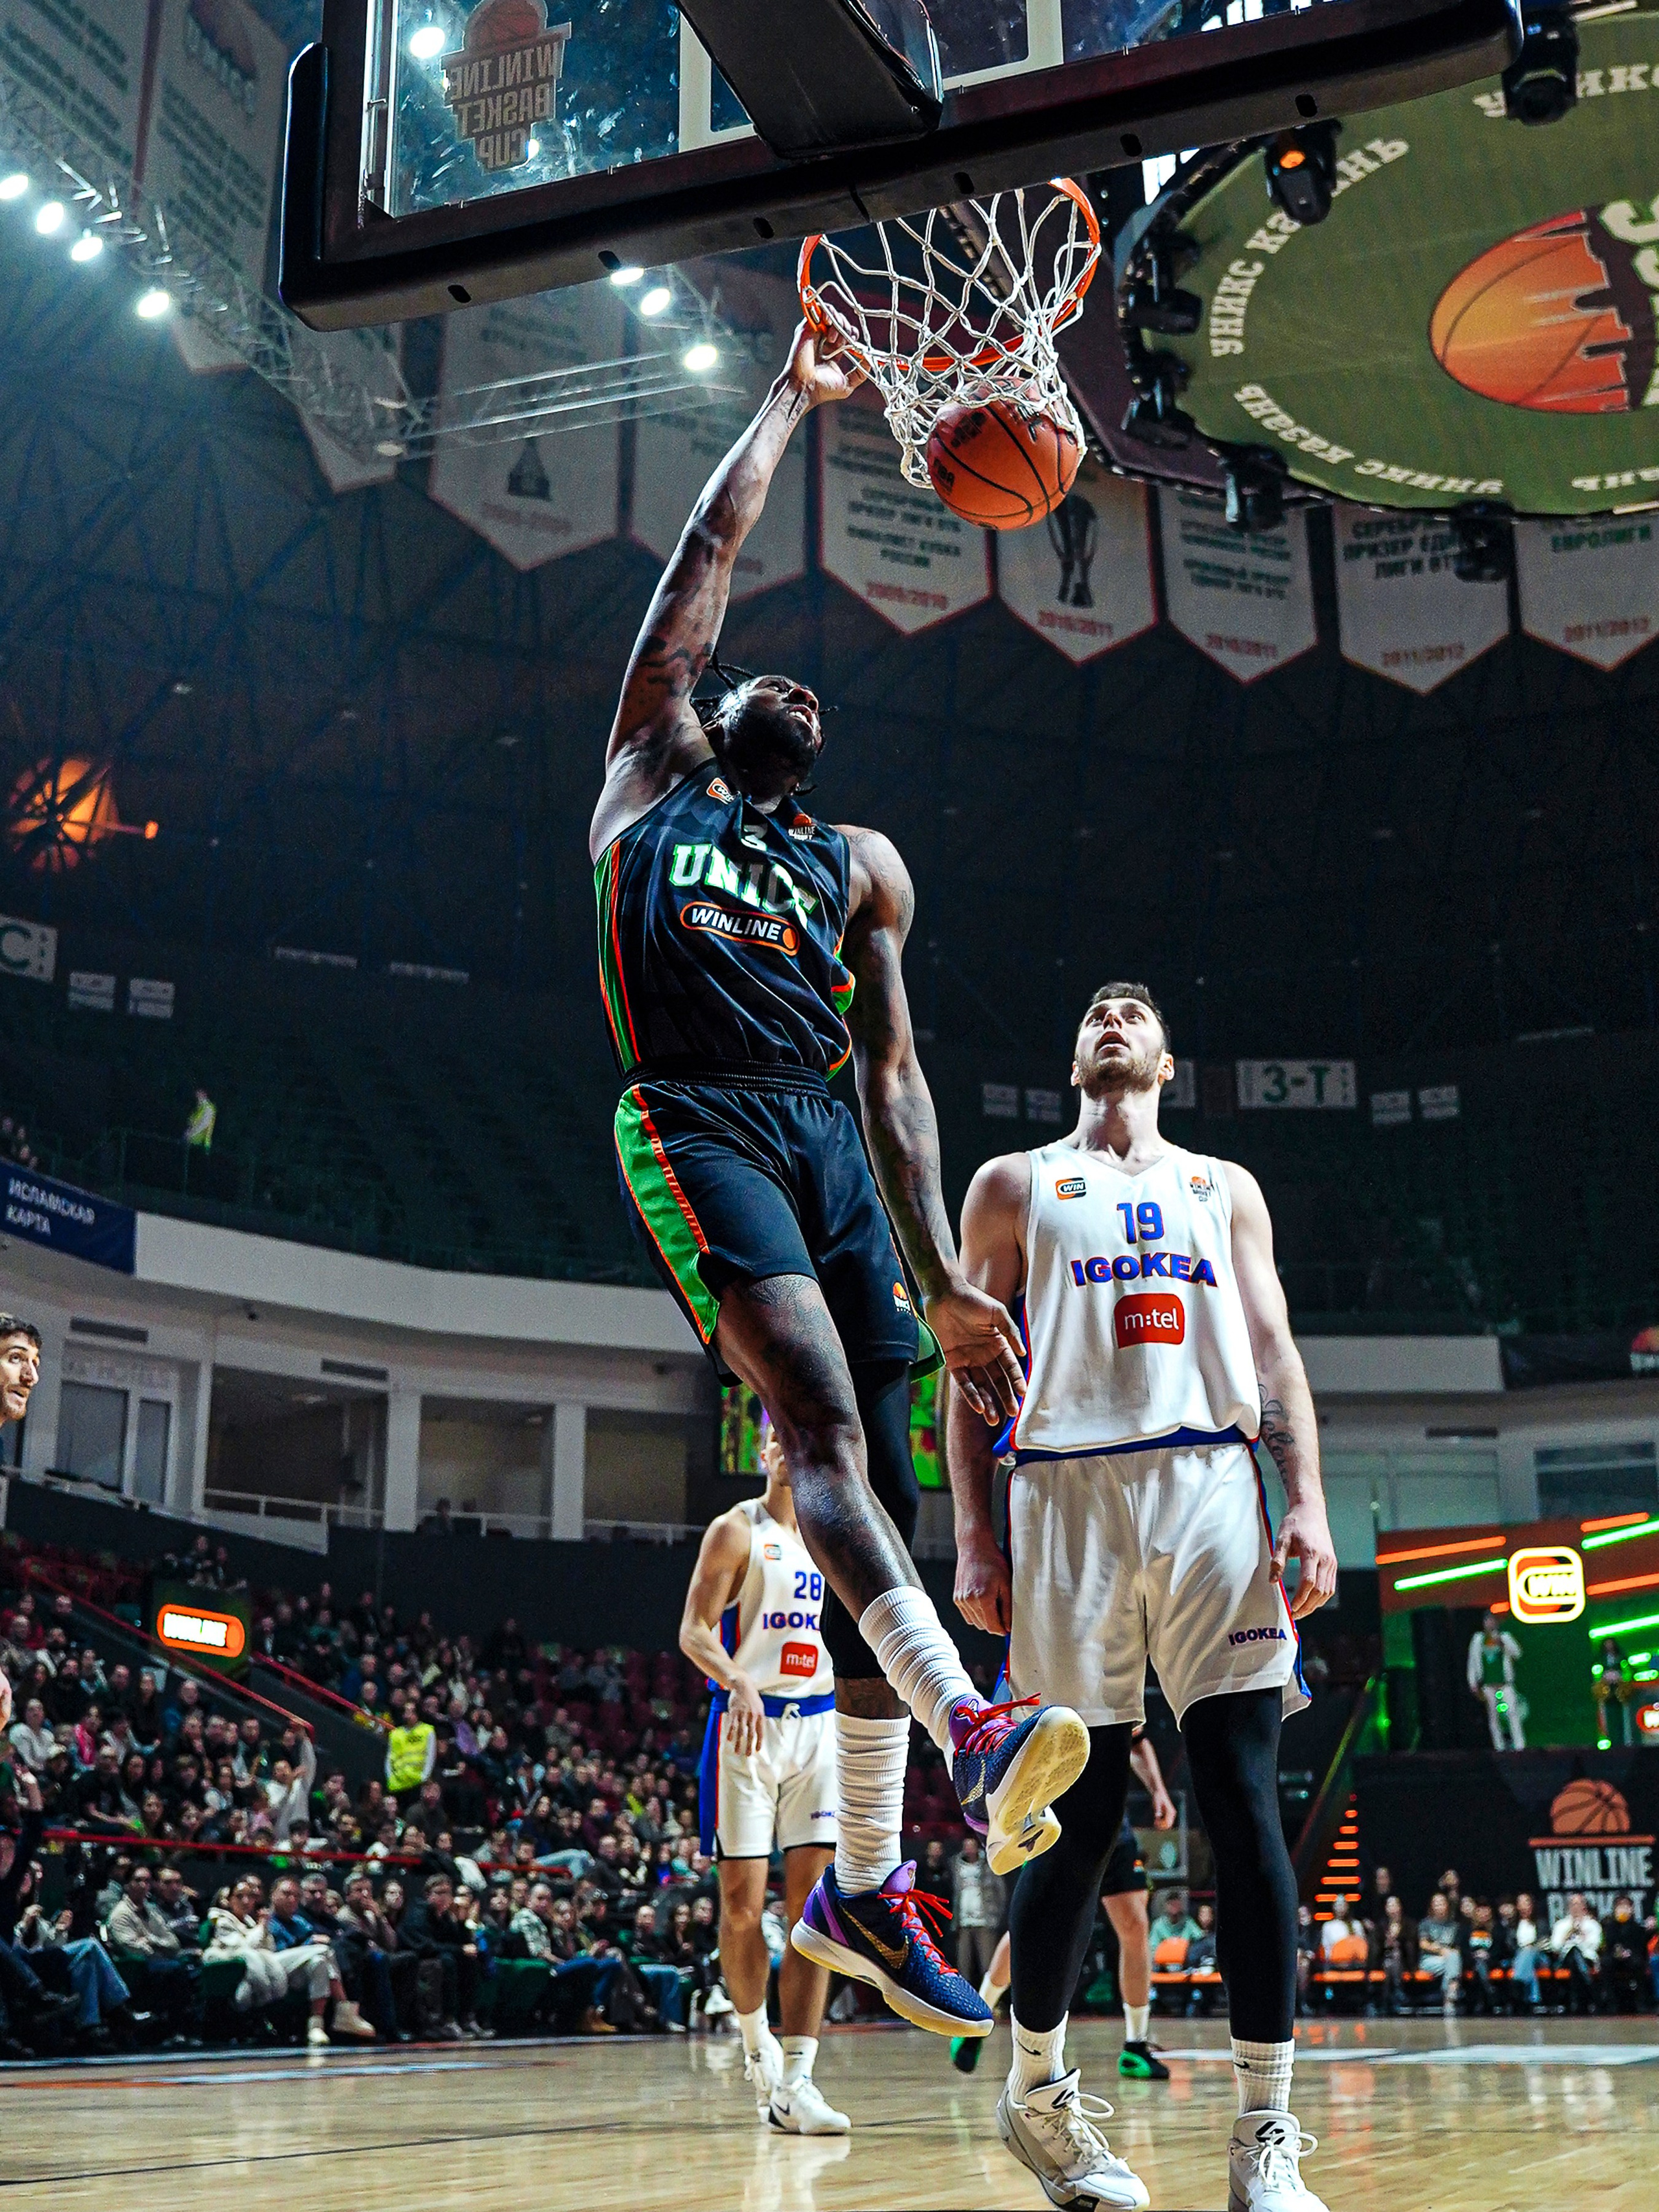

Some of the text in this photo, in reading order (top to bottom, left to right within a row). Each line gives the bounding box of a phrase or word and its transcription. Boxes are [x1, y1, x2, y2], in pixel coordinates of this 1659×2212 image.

[1209, 259, 1264, 357] УНИКС
[691, 907, 782, 942] WINLINE
[1062, 1182, 1086, 1193] WIN
[1116, 1202, 1165, 1244] 19
[1070, 1252, 1218, 1287] IGOKEA
[1124, 1307, 1179, 1330] m:tel
[794, 1571, 822, 1601] 28
[763, 1612, 820, 1631] IGOK
[1227, 1627, 1288, 1646] IGOKEA
[1534, 1846, 1654, 1891] WINLINE
